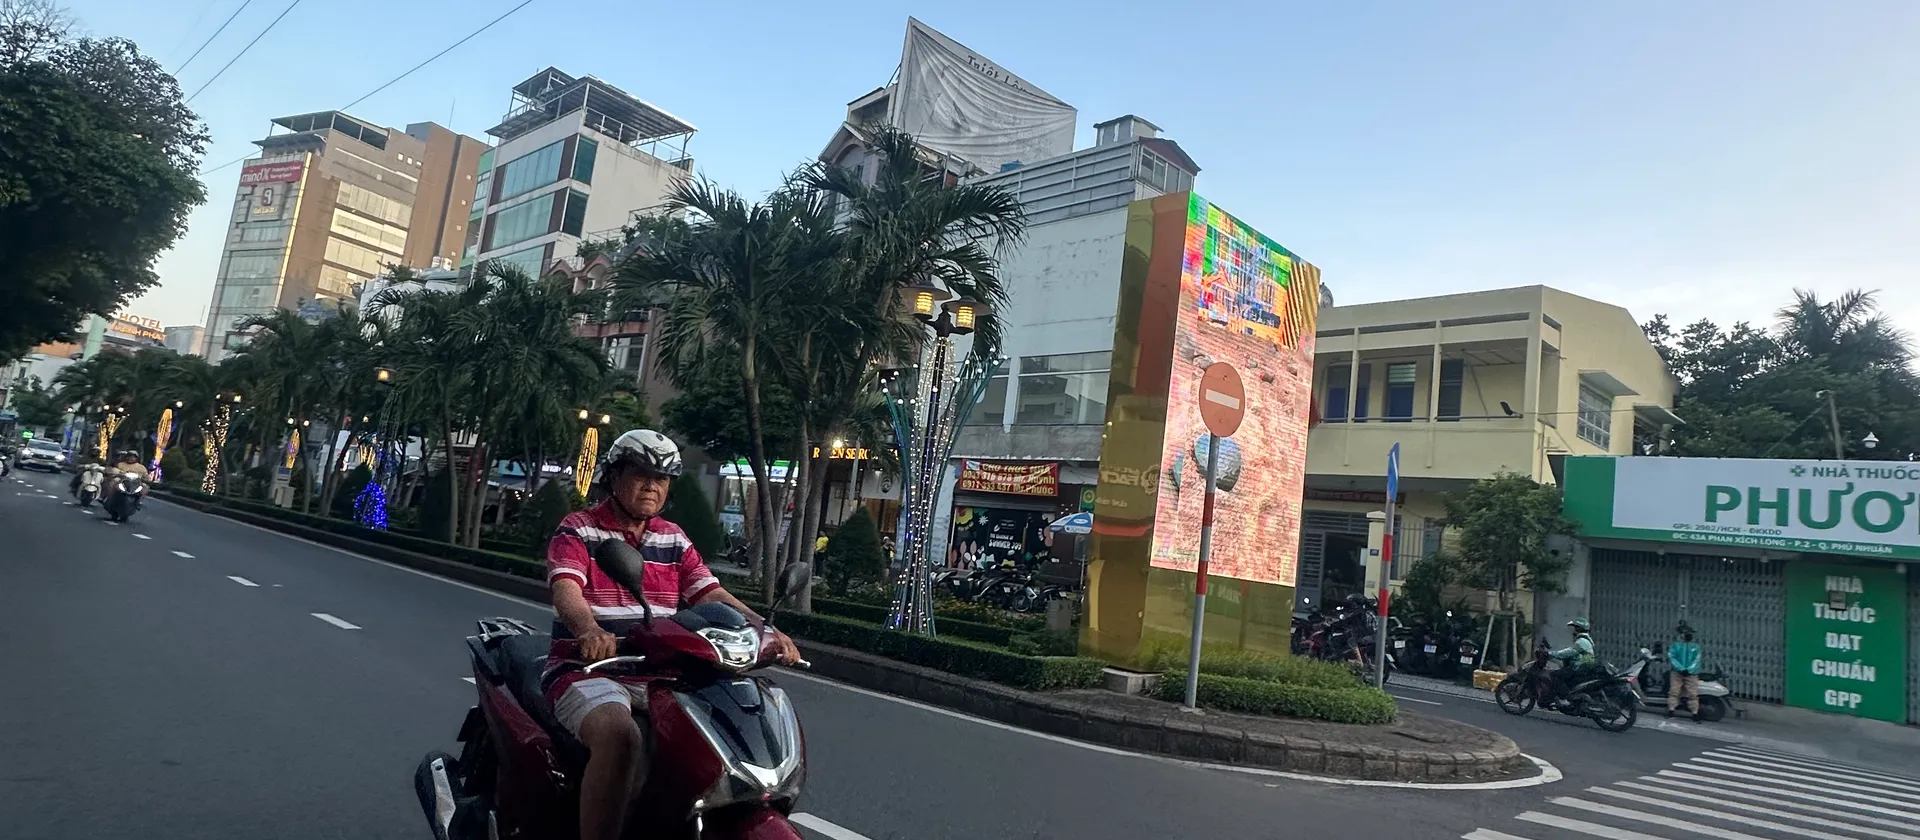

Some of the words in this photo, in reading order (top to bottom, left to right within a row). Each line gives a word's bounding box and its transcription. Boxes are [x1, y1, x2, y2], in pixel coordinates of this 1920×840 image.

[120, 312, 162, 331] HOTEL
[1812, 465, 1850, 478] NHÀ
[1705, 482, 1920, 535] PHƯƠ
[1689, 533, 1706, 541] 43A
[1708, 534, 1733, 543] PHAN
[1760, 538, 1786, 546] LONG
[1795, 540, 1810, 548] P.2
[1825, 575, 1863, 594] NHÀ
[1825, 632, 1863, 652] ĐẠT
[1825, 689, 1862, 709] GPP
